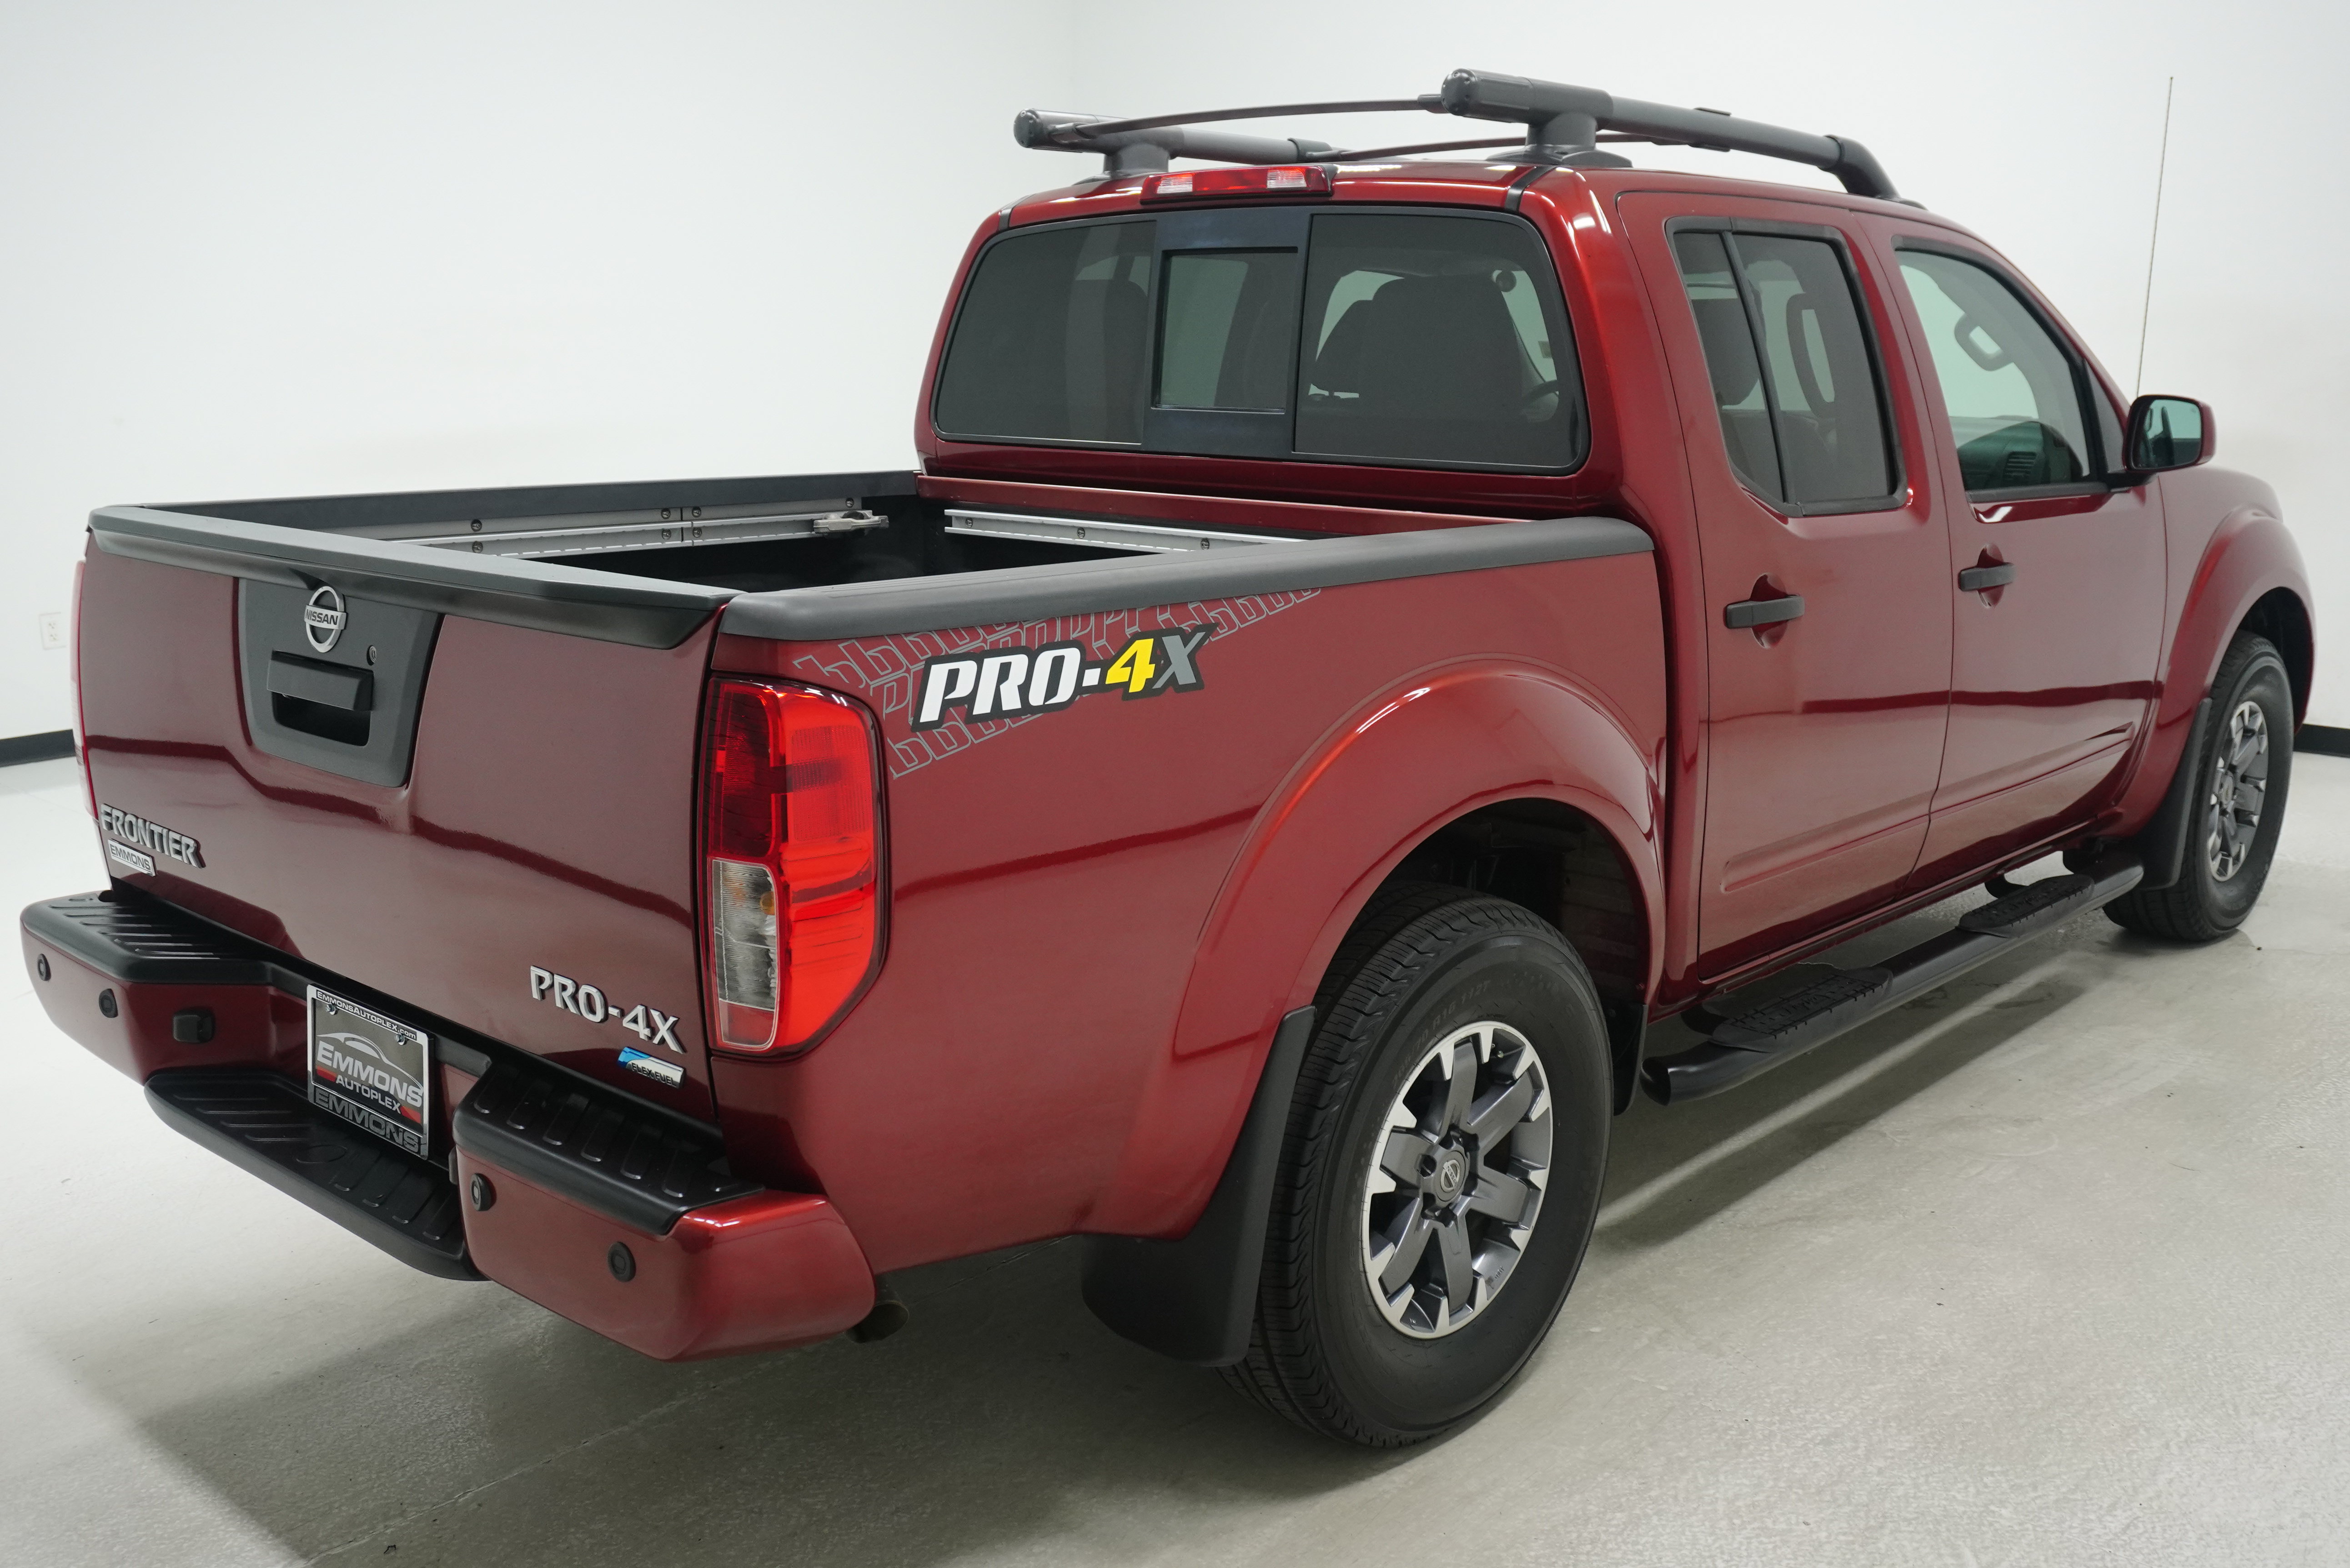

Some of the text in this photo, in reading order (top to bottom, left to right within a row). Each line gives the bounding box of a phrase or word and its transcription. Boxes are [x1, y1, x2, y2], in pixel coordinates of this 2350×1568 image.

[306, 609, 338, 625] NISSAN
[919, 632, 1204, 724] PRO-4X
[101, 804, 205, 868] FRONTIER
[110, 844, 151, 869] EMMONS
[531, 965, 685, 1054] PRO-4X
[316, 1041, 423, 1108] EMMONS
[336, 1075, 402, 1114] AUTOPLEX
[631, 1062, 677, 1088] FLEX FUEL
[315, 1088, 419, 1153] EMMONS
